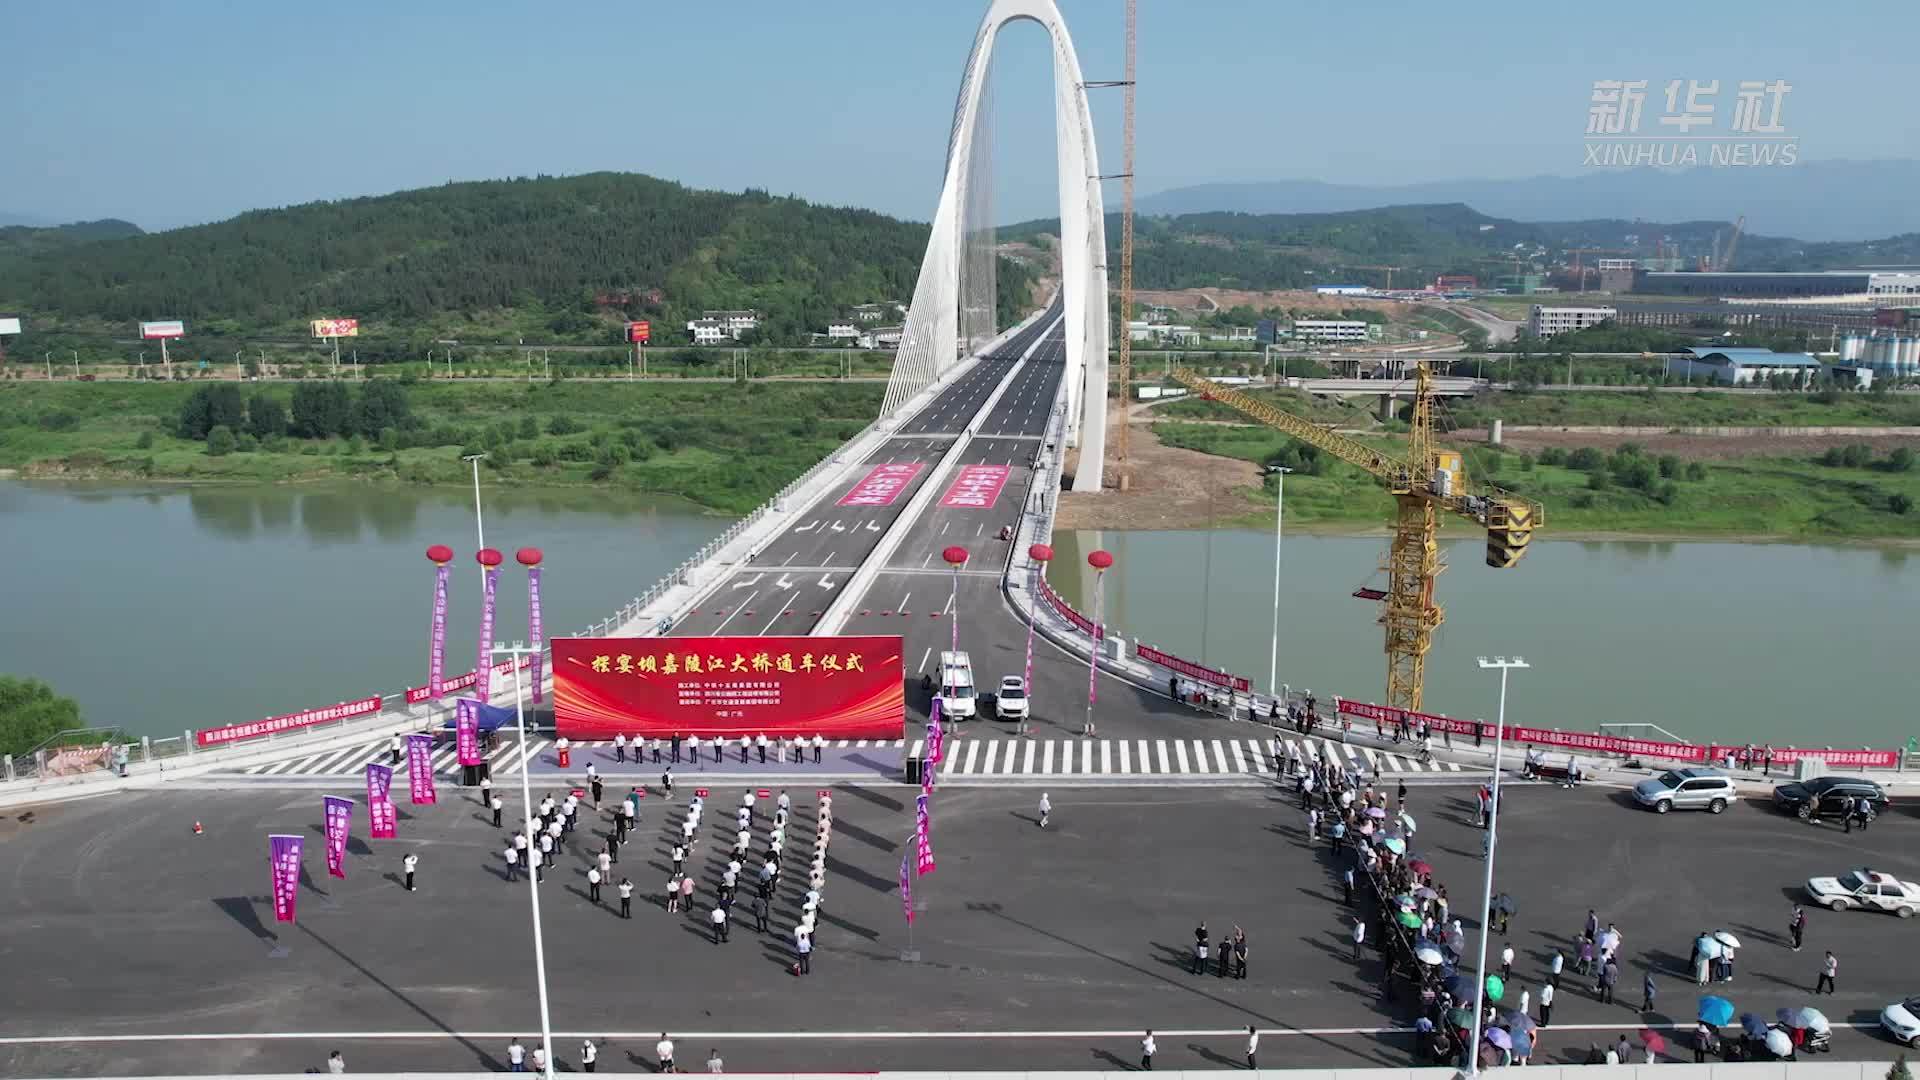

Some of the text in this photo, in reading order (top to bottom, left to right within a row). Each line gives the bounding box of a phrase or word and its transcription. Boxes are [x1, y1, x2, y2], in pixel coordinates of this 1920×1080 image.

[591, 652, 865, 675] 摆宴坝嘉陵江大桥通车仪式
